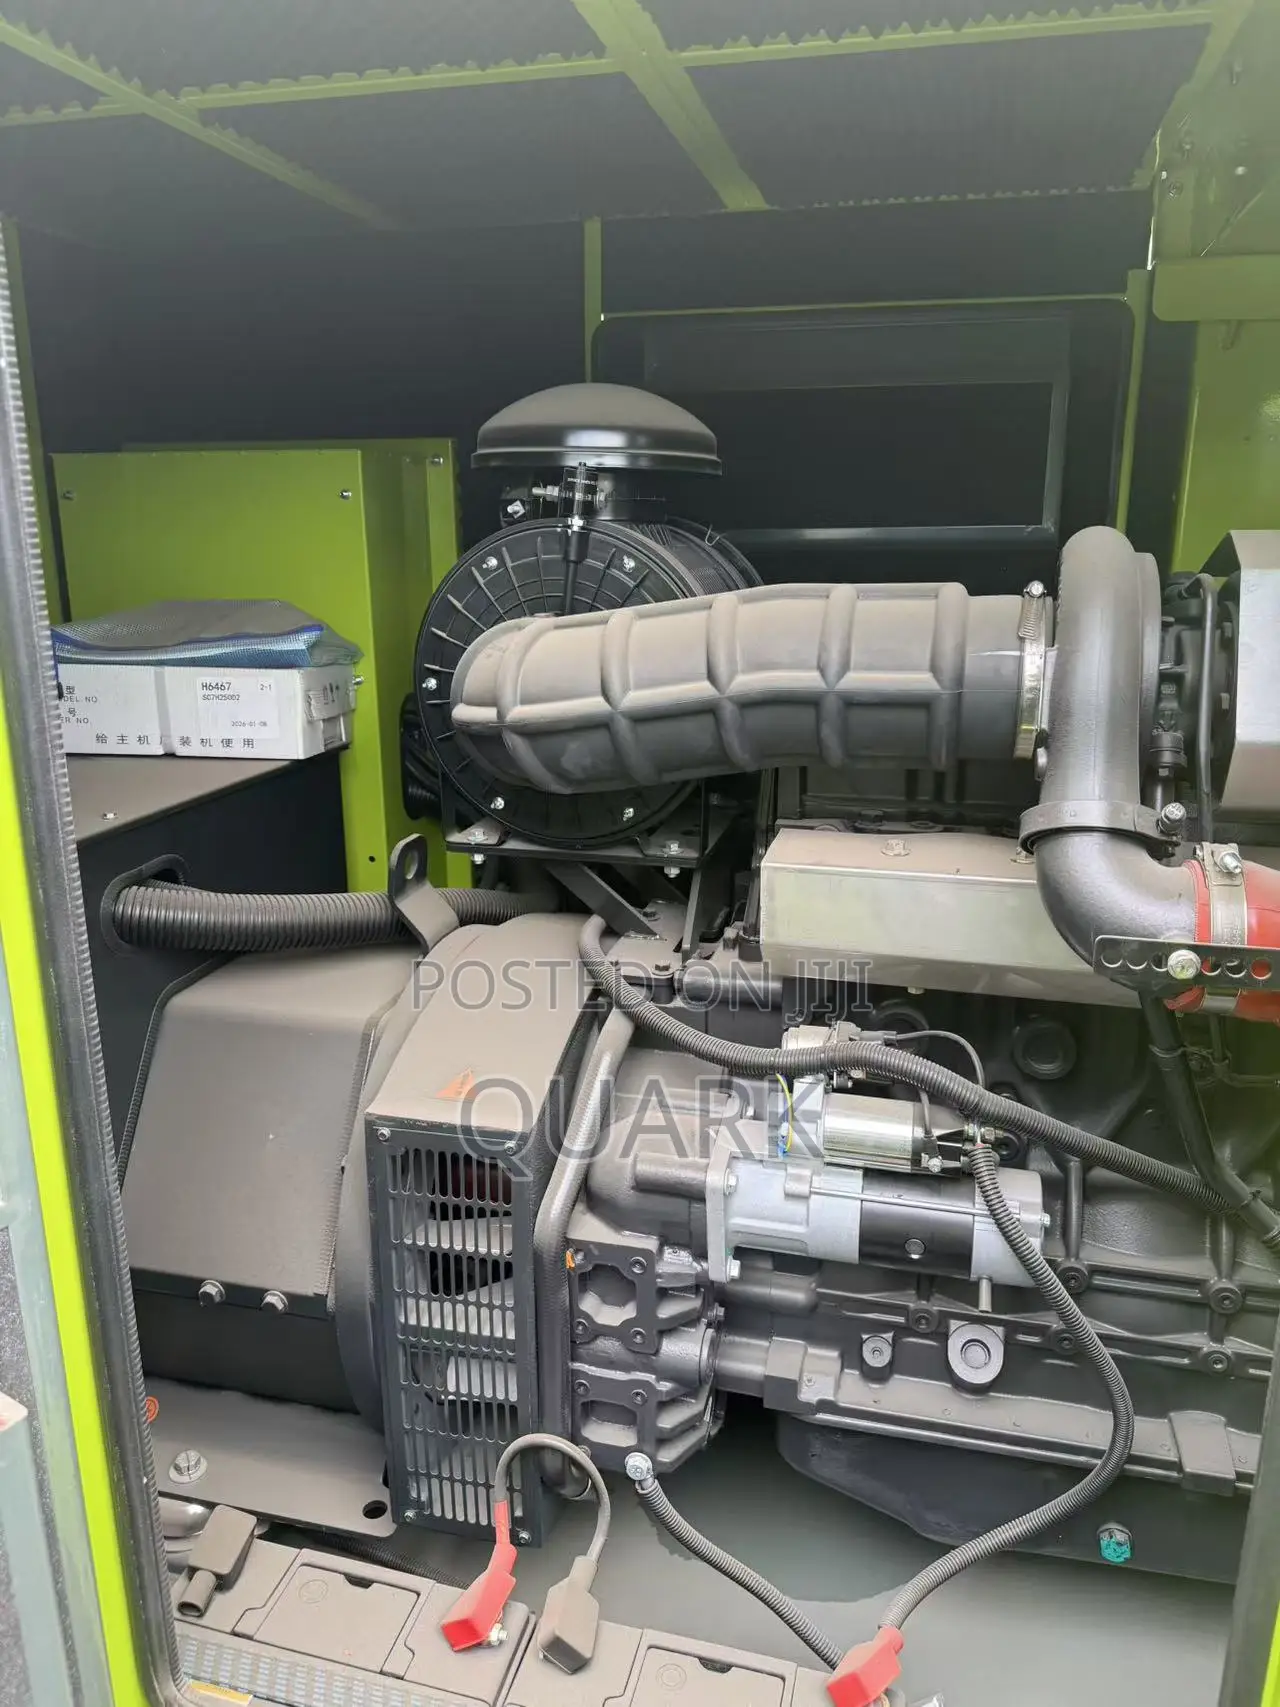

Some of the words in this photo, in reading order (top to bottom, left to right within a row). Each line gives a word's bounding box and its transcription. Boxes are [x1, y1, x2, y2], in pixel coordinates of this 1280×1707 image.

[65, 685, 76, 695] 型
[201, 682, 231, 691] H6467
[260, 683, 272, 691] 2-1
[67, 707, 77, 717] 号
